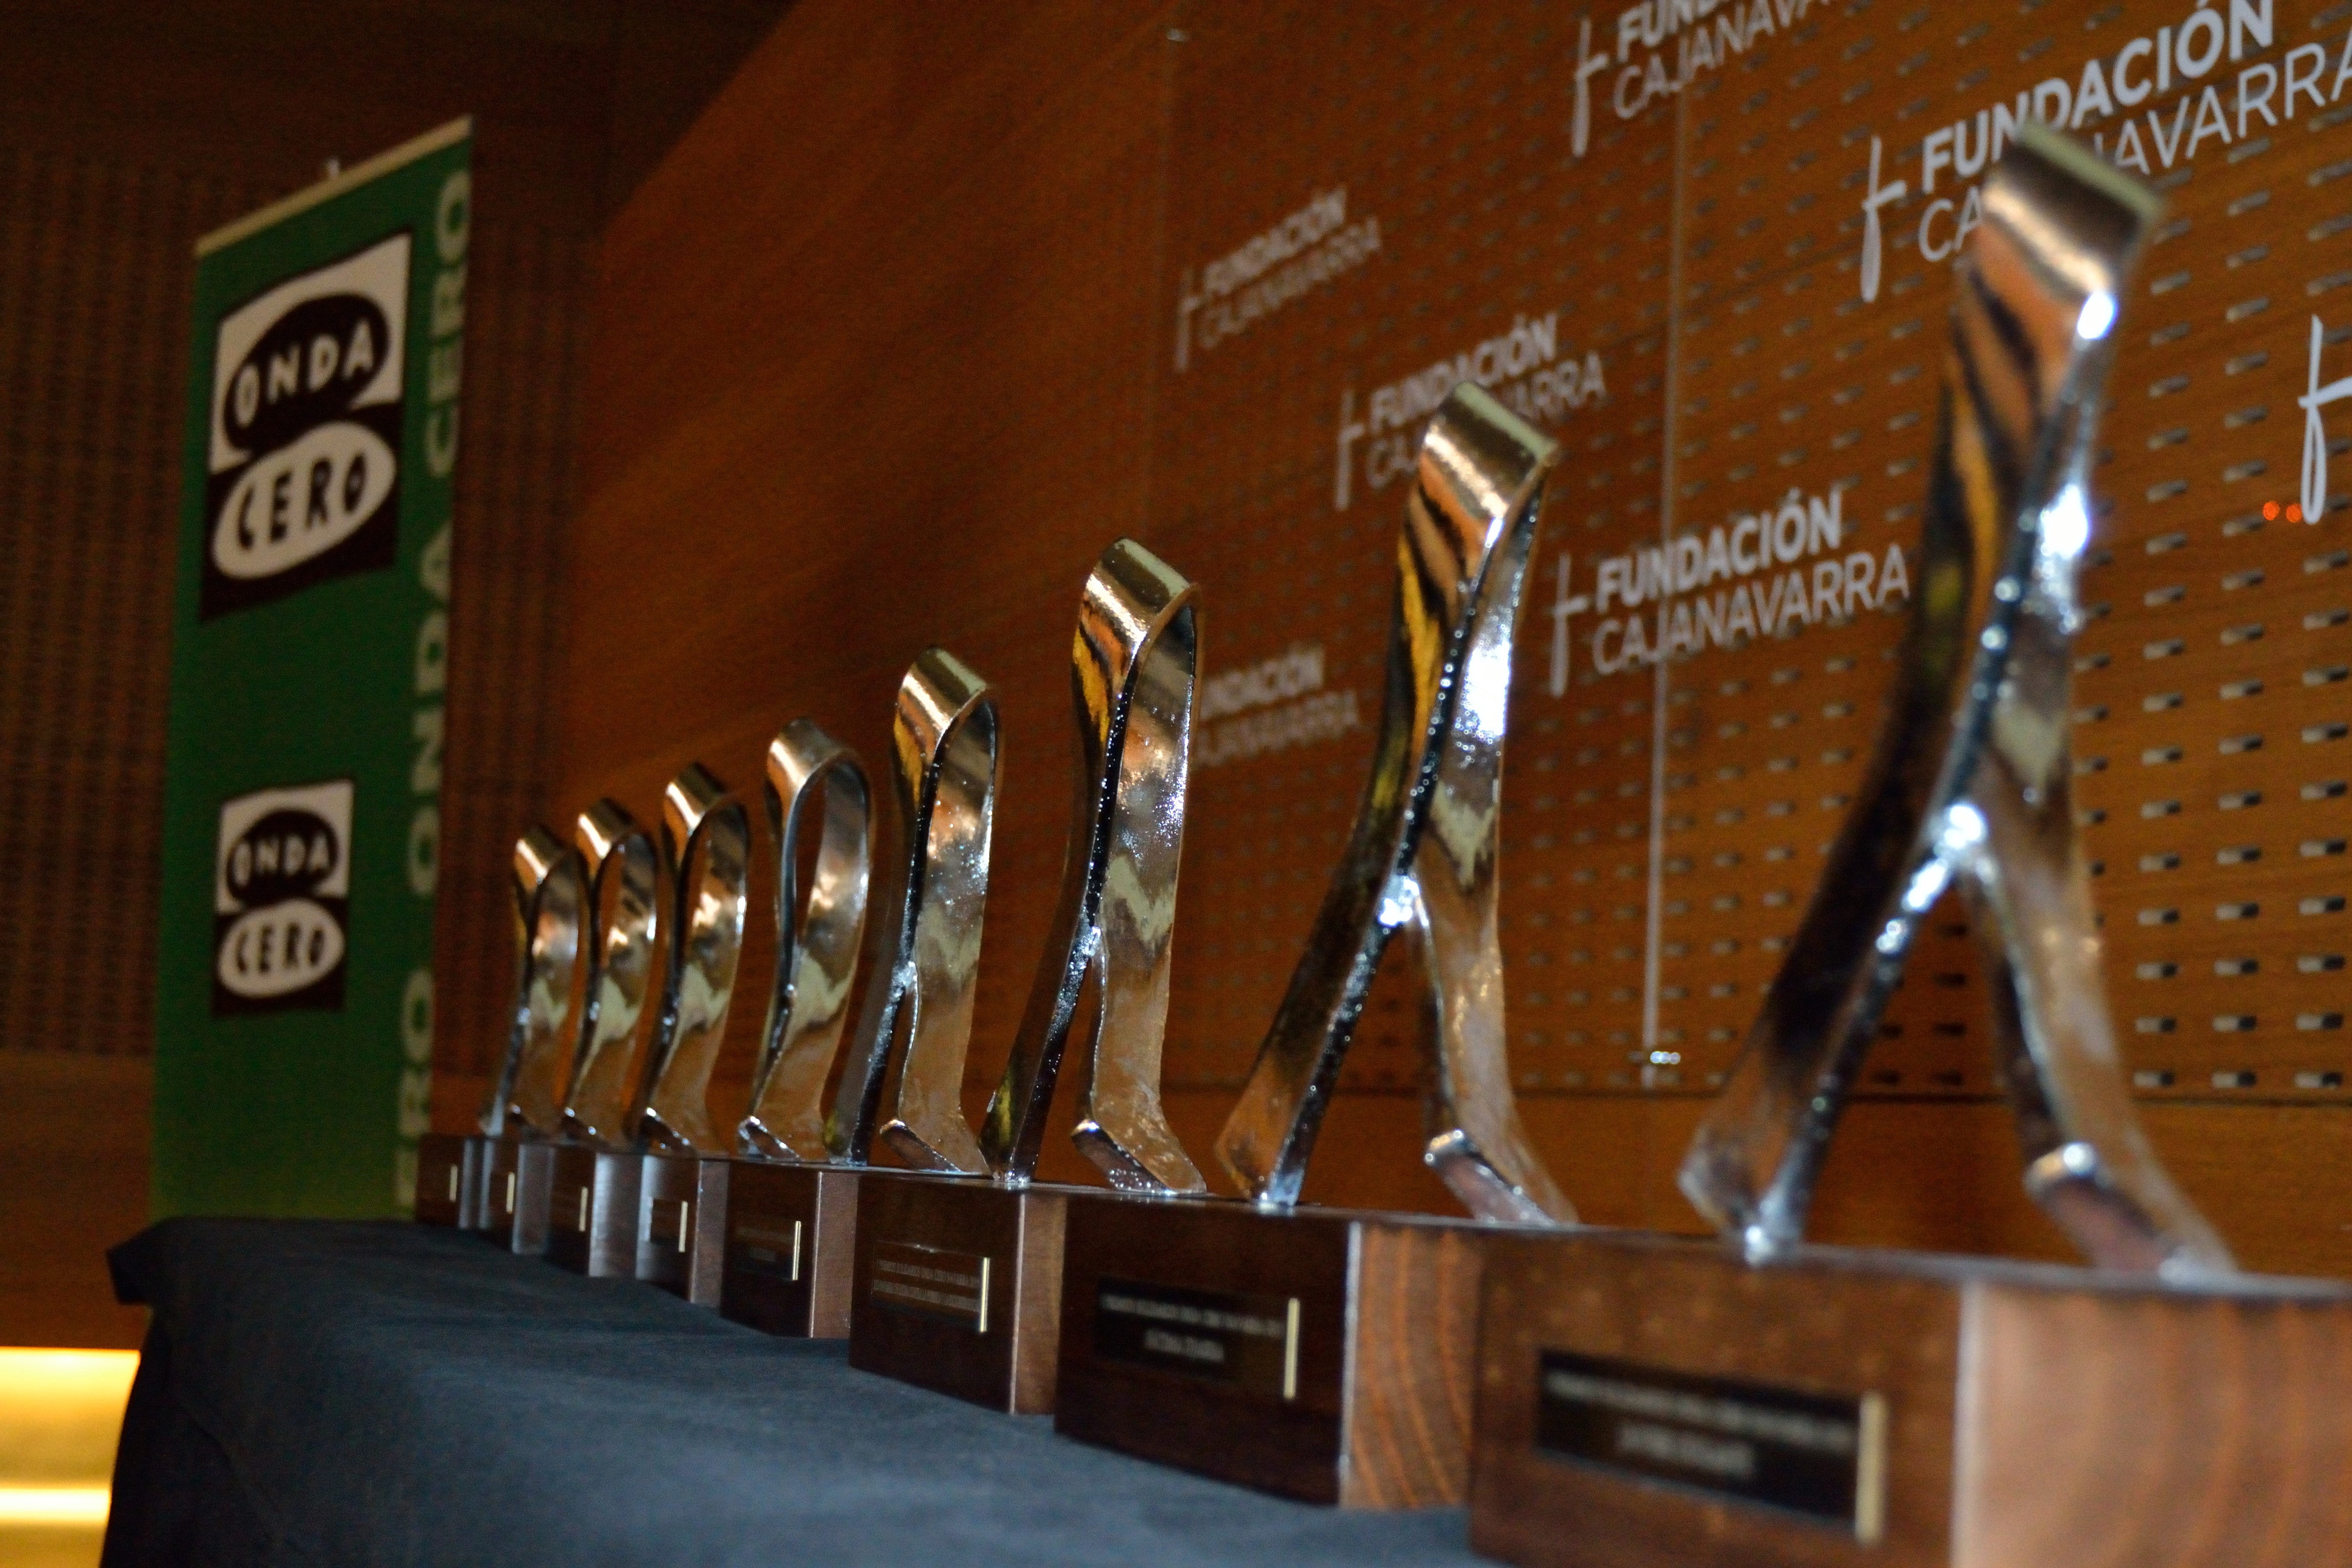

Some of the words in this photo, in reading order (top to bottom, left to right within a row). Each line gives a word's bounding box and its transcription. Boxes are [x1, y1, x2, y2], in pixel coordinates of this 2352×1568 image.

[234, 315, 374, 430] ONDA
[234, 448, 370, 555] CERO
[1596, 487, 1842, 614] FUNDACIÓN
[1592, 544, 1910, 676] CAJANAVARRA
[233, 832, 329, 888] ONDA
[233, 918, 326, 977] CERO
